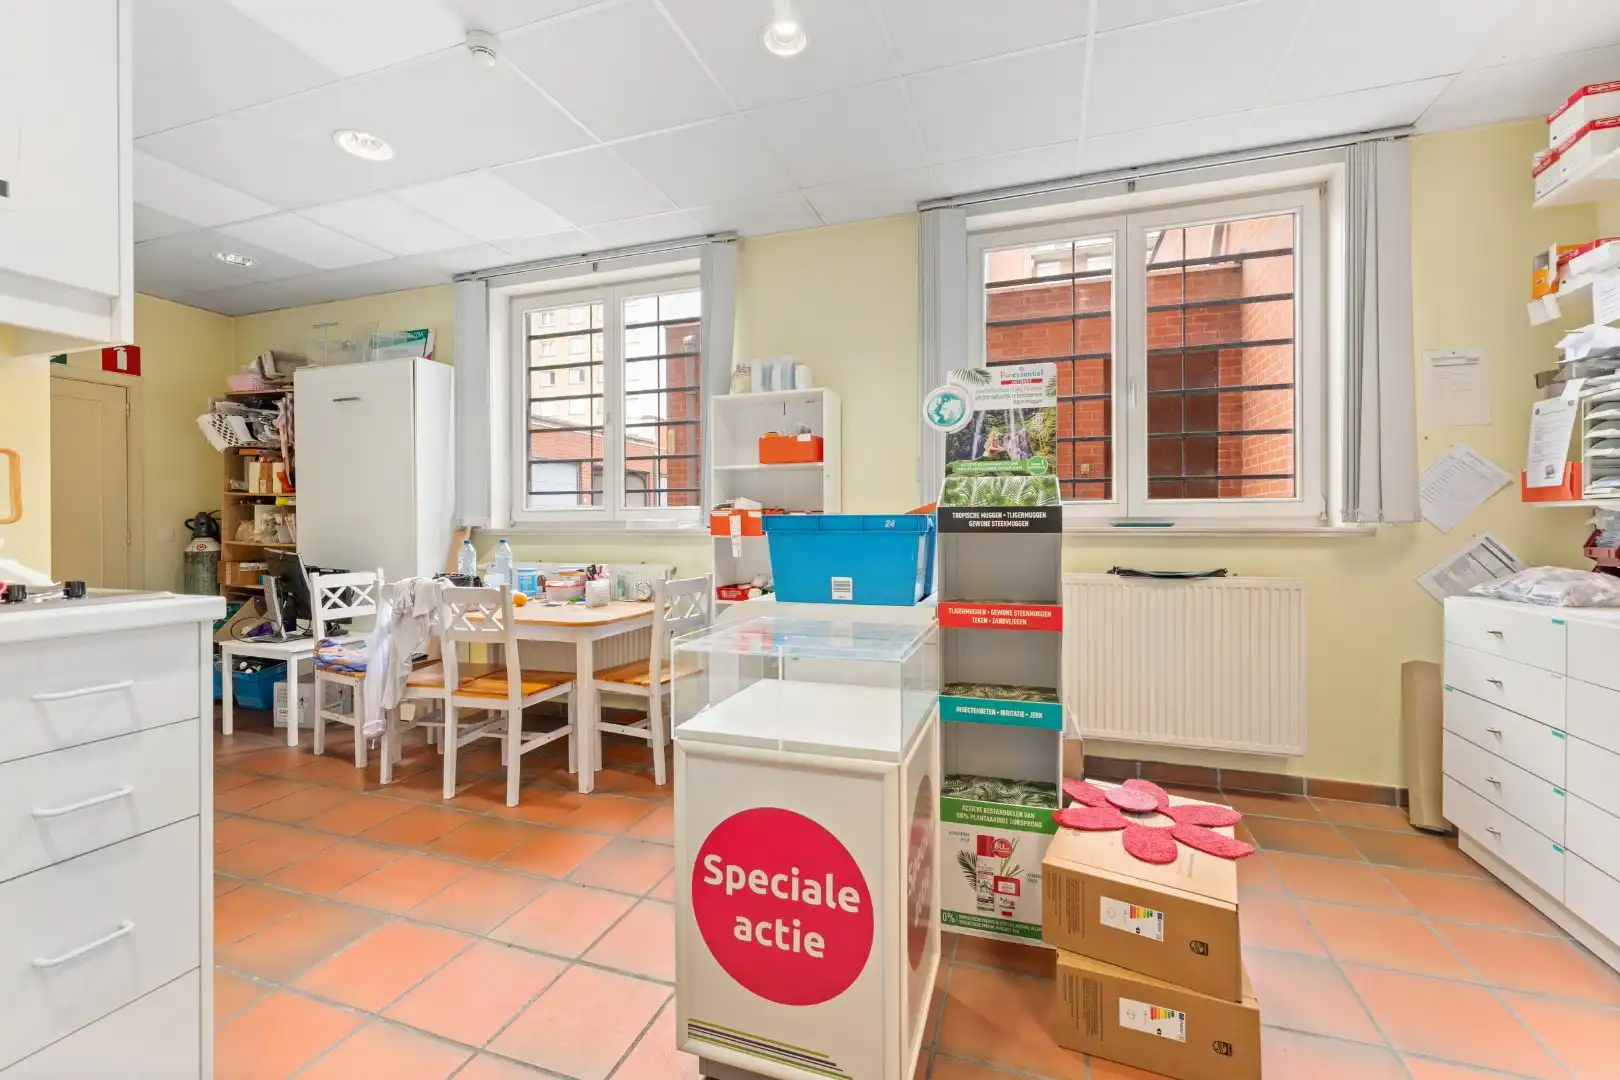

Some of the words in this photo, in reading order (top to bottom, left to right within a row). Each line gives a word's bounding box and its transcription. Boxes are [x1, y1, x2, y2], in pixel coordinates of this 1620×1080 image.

[884, 519, 896, 528] 24
[948, 607, 987, 615] TIJGERMUGGEN
[991, 608, 1012, 616] GEWONE
[1014, 610, 1052, 618] STEEKMUGGEN
[956, 706, 996, 715] INSECTENBETEN
[1000, 709, 1025, 718] IRRITATIE
[961, 805, 982, 813] ACTIEVE
[983, 807, 1023, 817] BESTANDDELEN
[1024, 811, 1035, 819] VAN
[956, 812, 969, 820] 100%
[970, 813, 1009, 825] PLANTAARDIGE
[1010, 819, 1042, 828] OORSPRONG
[703, 854, 860, 913] Speciale
[942, 912, 956, 923] 0%
[733, 915, 825, 958] actie
